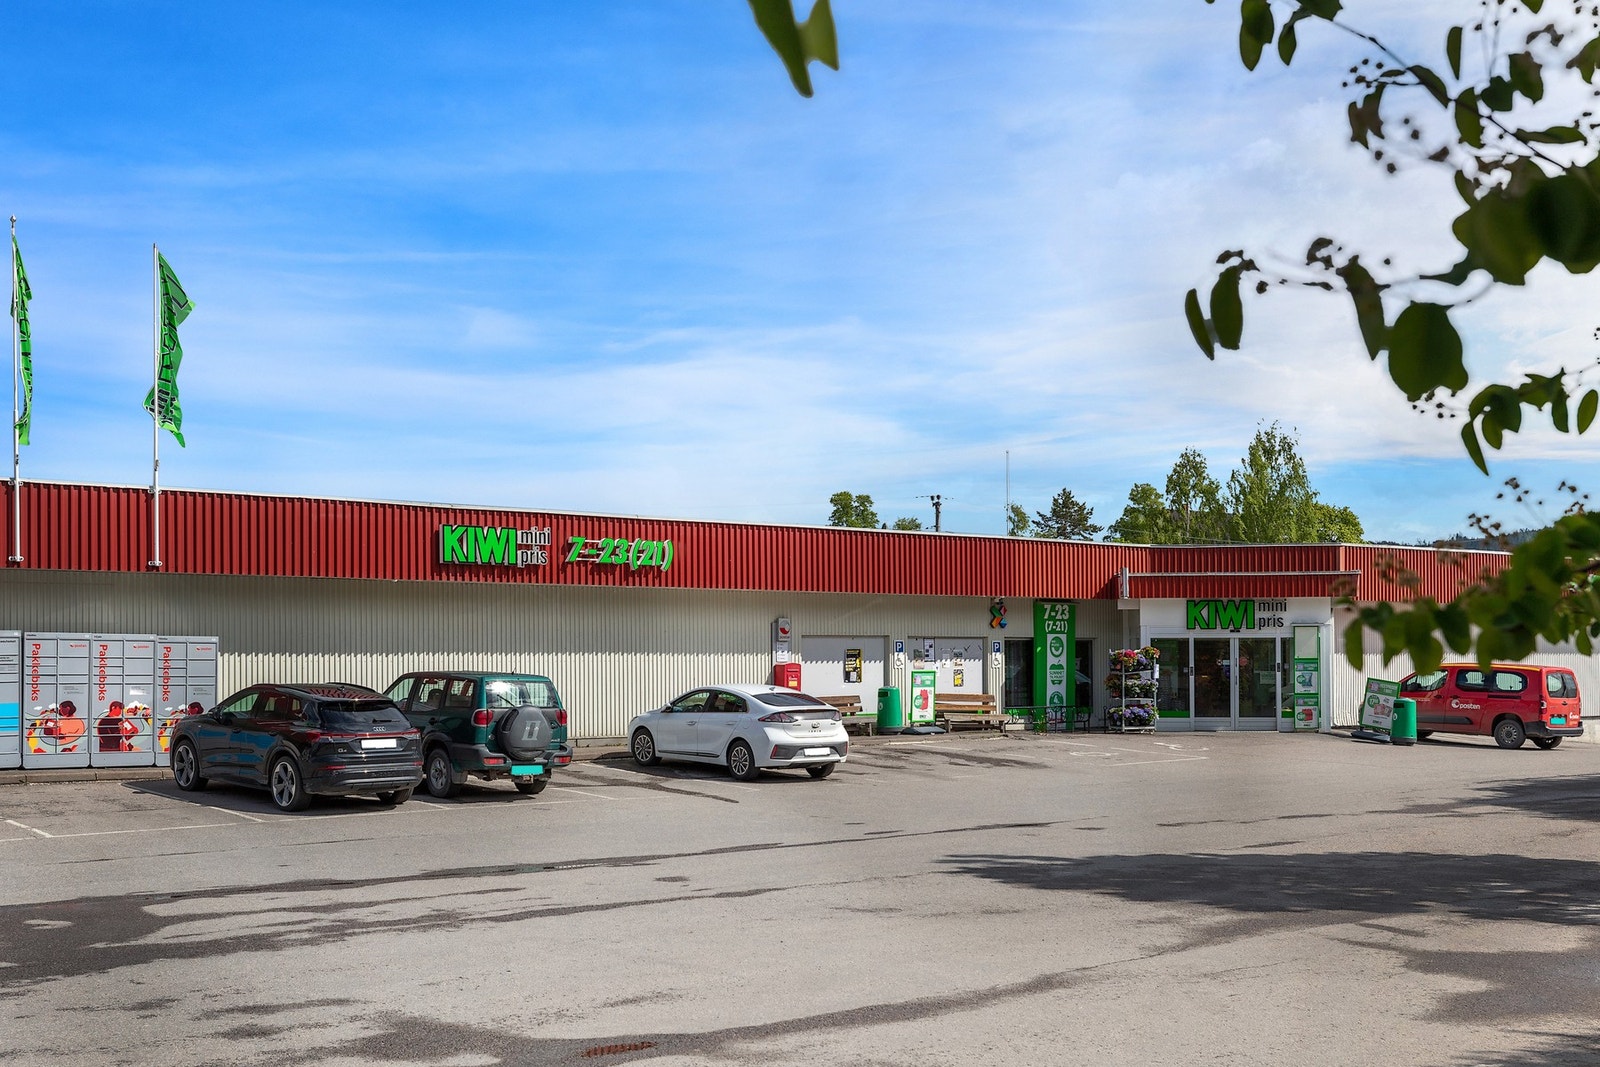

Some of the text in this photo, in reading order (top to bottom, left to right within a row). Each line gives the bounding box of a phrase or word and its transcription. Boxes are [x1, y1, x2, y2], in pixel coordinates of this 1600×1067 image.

[520, 527, 551, 545] mini
[442, 524, 517, 566] KIWI
[520, 546, 548, 568] pris
[1043, 604, 1070, 620] 7-23
[1258, 598, 1287, 612] mini
[1186, 599, 1255, 630] KIWI
[1258, 614, 1285, 630] pris
[1044, 621, 1068, 633] (7-21)
[896, 643, 903, 652] P
[994, 643, 1000, 653] P
